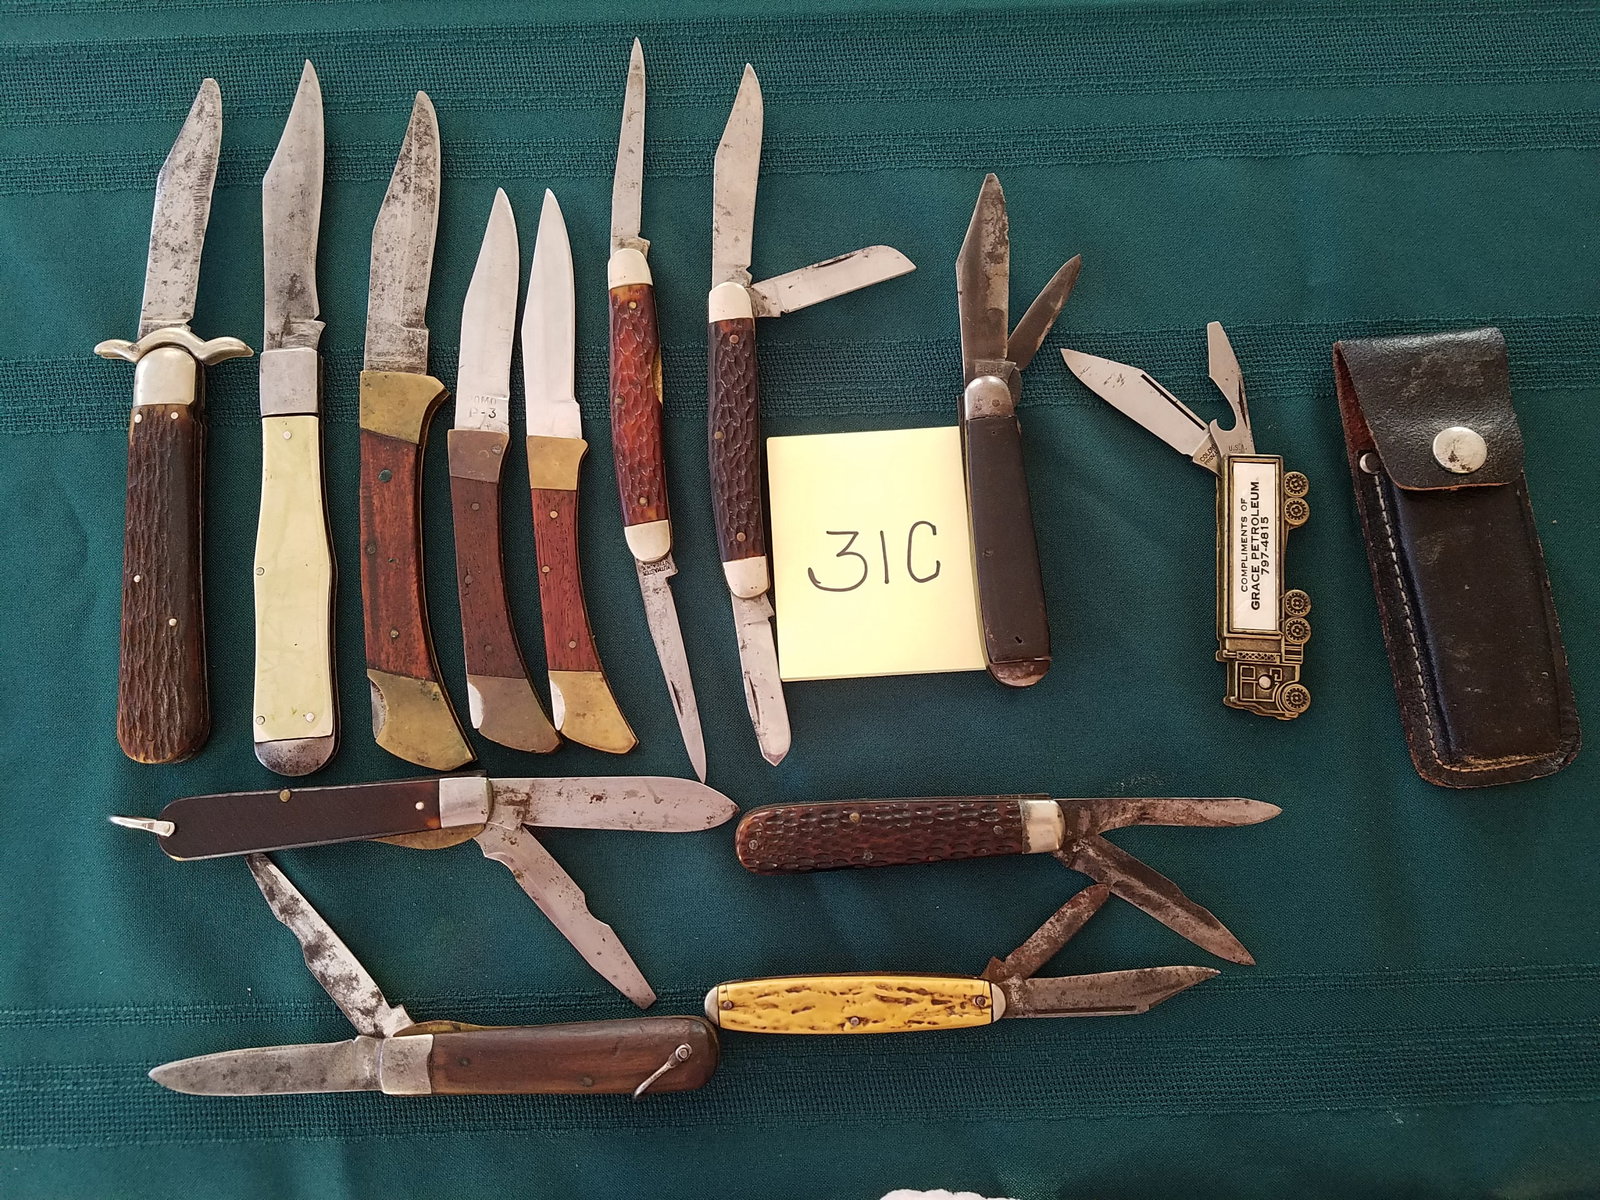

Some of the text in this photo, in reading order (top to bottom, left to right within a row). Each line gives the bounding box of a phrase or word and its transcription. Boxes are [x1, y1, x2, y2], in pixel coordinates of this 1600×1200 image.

[1241, 498, 1248, 511] OF
[807, 520, 941, 593] 31C
[1251, 481, 1260, 610] GRACE PETROLEUM
[1261, 517, 1269, 575] 797-4815
